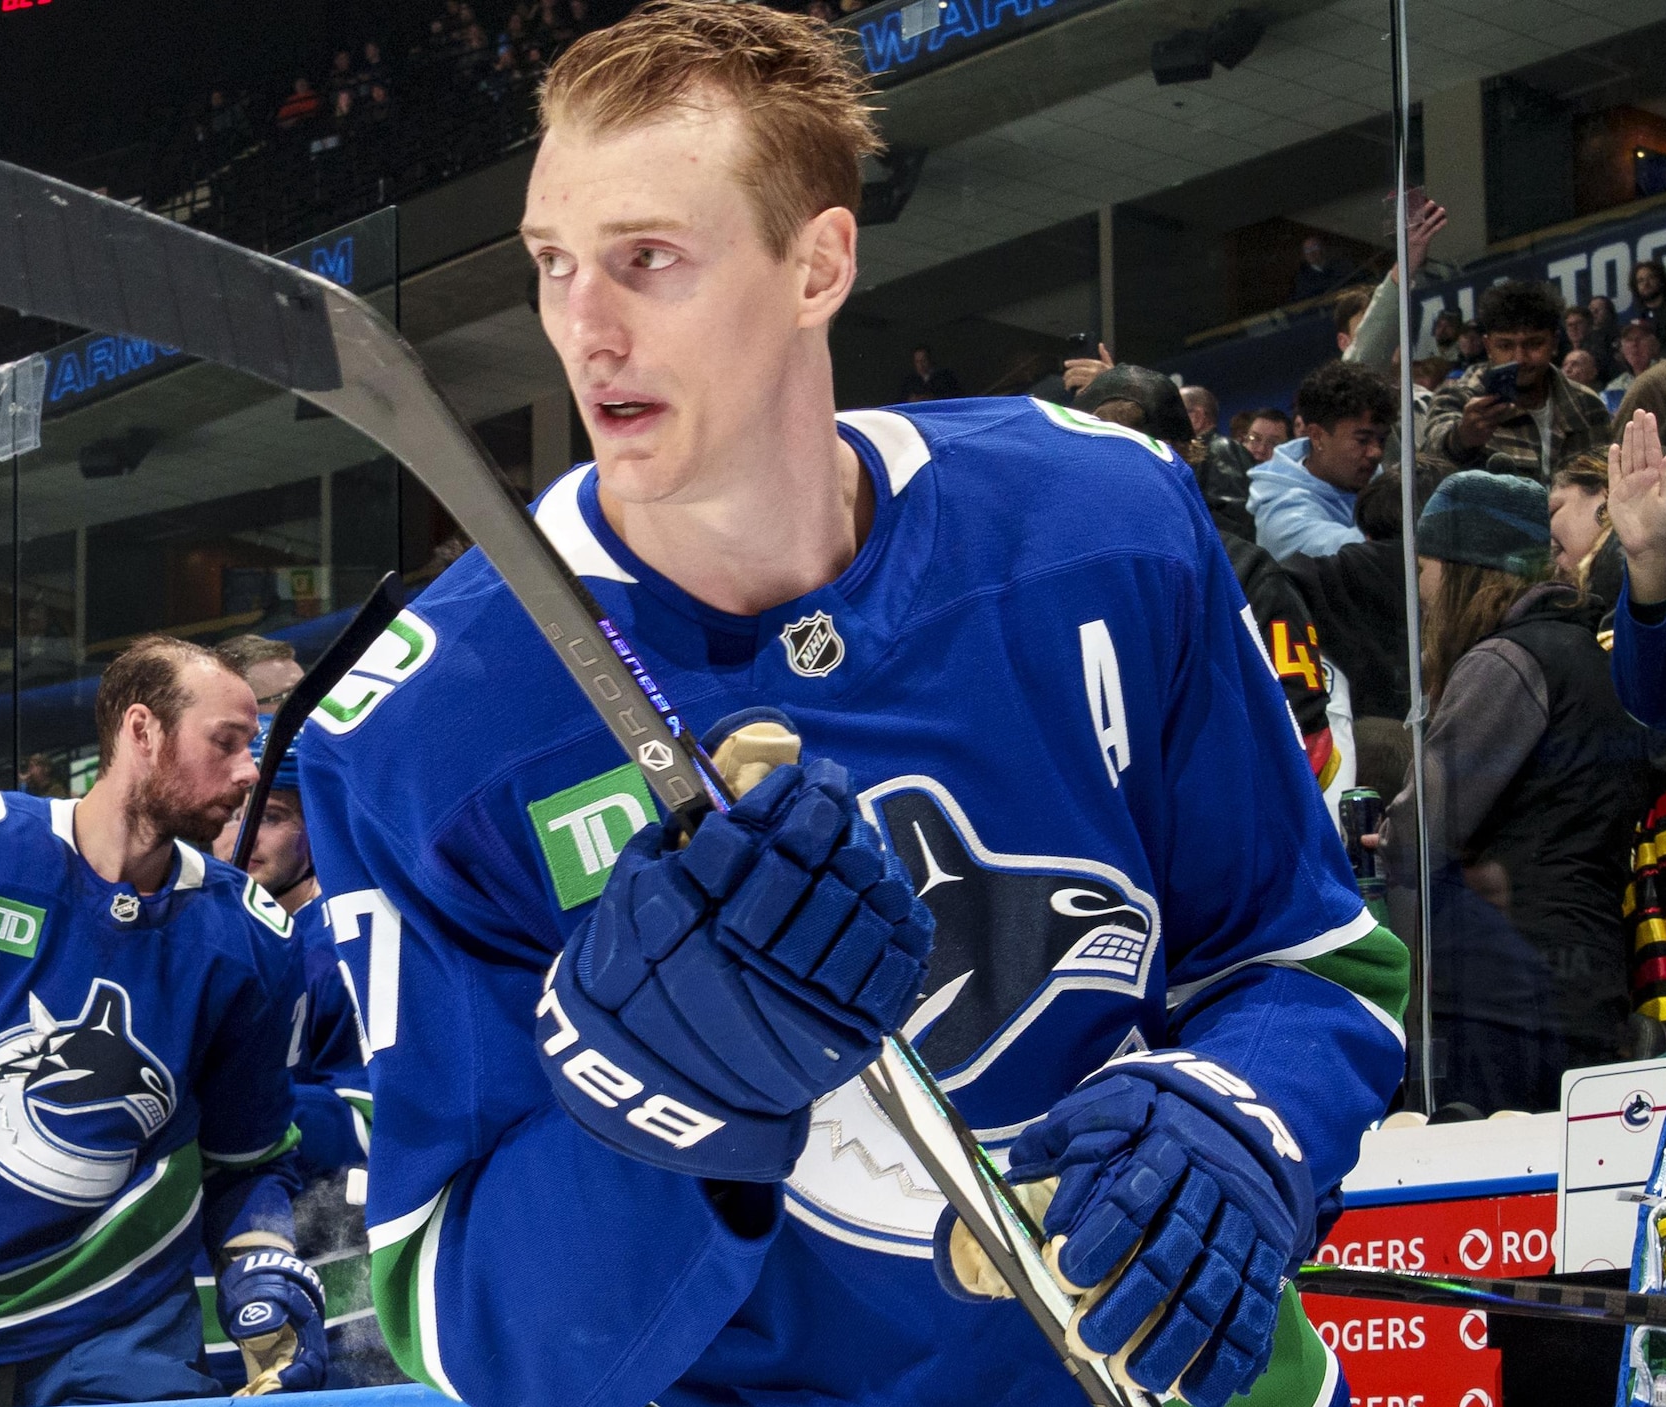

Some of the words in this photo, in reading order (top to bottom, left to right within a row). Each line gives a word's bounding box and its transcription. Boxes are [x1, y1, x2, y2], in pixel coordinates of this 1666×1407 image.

[1078, 619, 1130, 789] A
[323, 887, 402, 1066] 7
[1316, 1236, 1427, 1271] OGERS
[1319, 1314, 1427, 1353] OGERS
